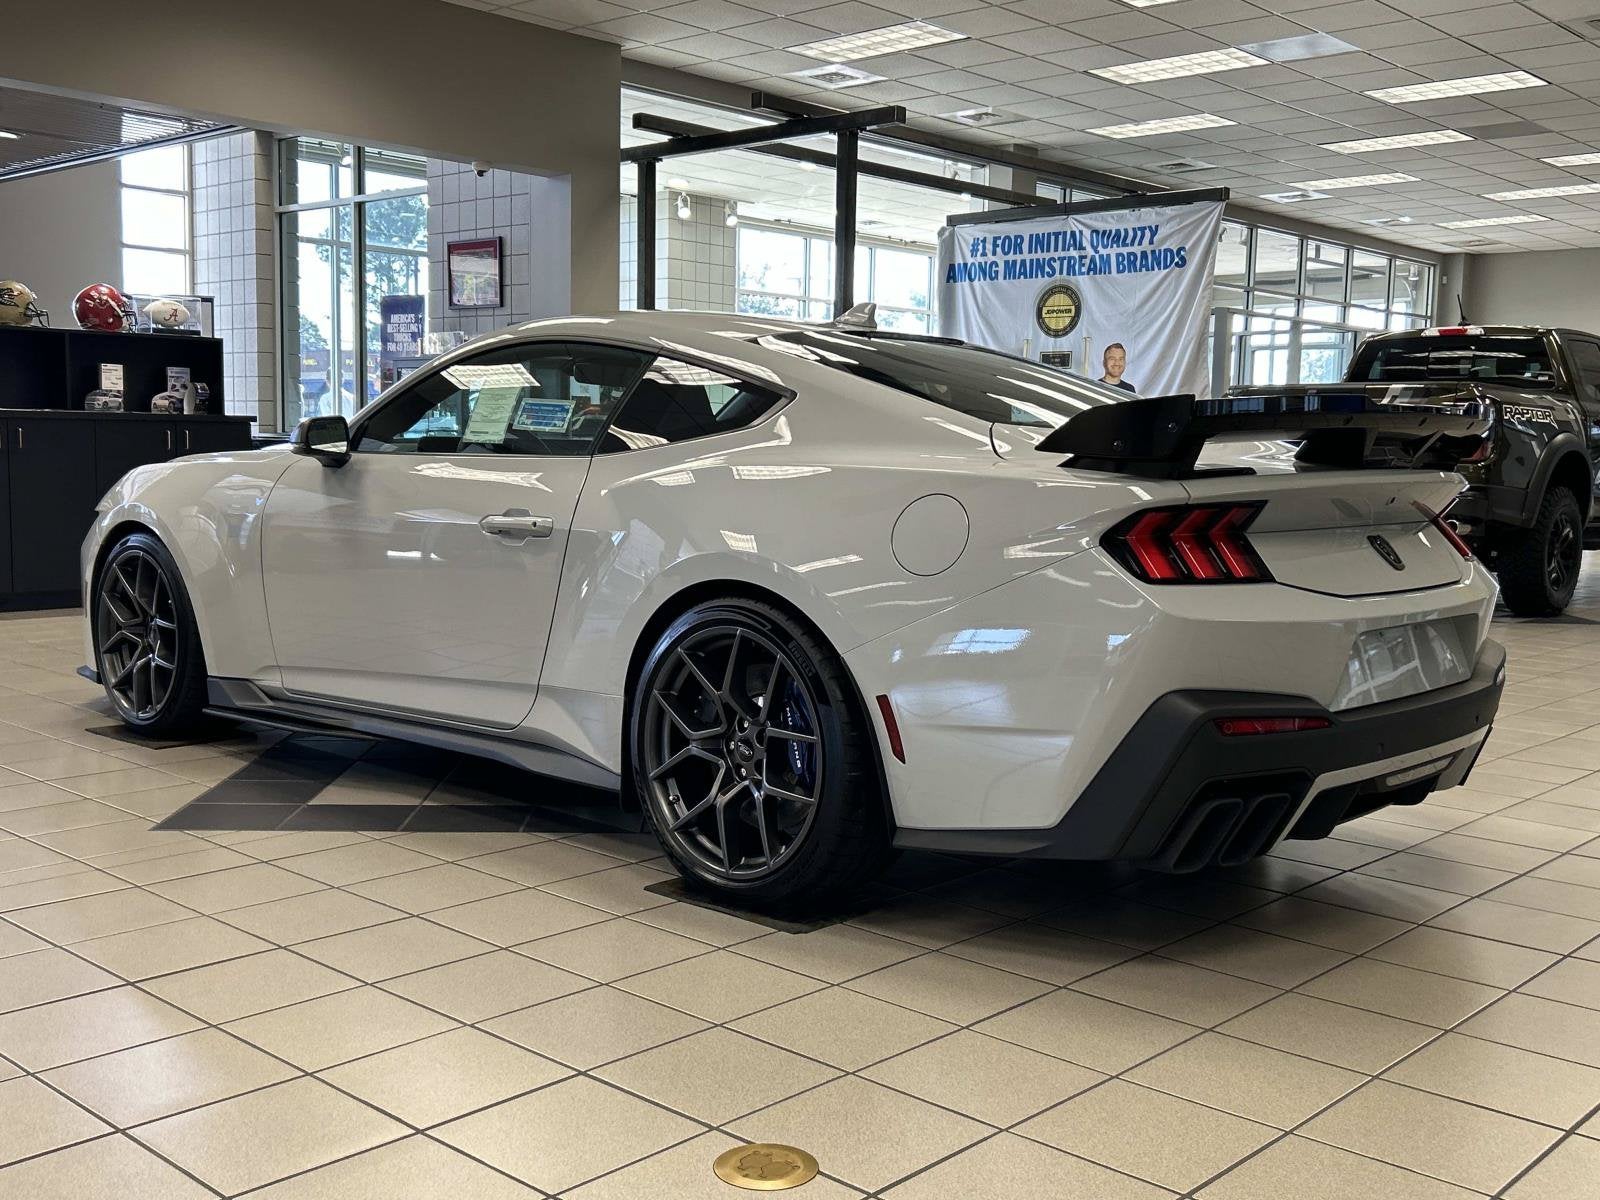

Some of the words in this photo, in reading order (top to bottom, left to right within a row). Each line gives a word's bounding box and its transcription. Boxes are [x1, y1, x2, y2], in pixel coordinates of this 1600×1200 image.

[970, 236, 988, 258] #1
[992, 234, 1024, 256] FOR
[1028, 229, 1086, 254] INITIAL
[1090, 225, 1159, 254] QUALITY
[946, 260, 999, 283] AMONG
[1003, 253, 1112, 280] MAINSTREAM
[1115, 246, 1187, 274] BRANDS
[390, 314, 415, 323] AMERICA'S
[387, 323, 418, 333] BEST-SELLING
[387, 342, 397, 351] FOR
[1502, 404, 1558, 429] RAPTOR
